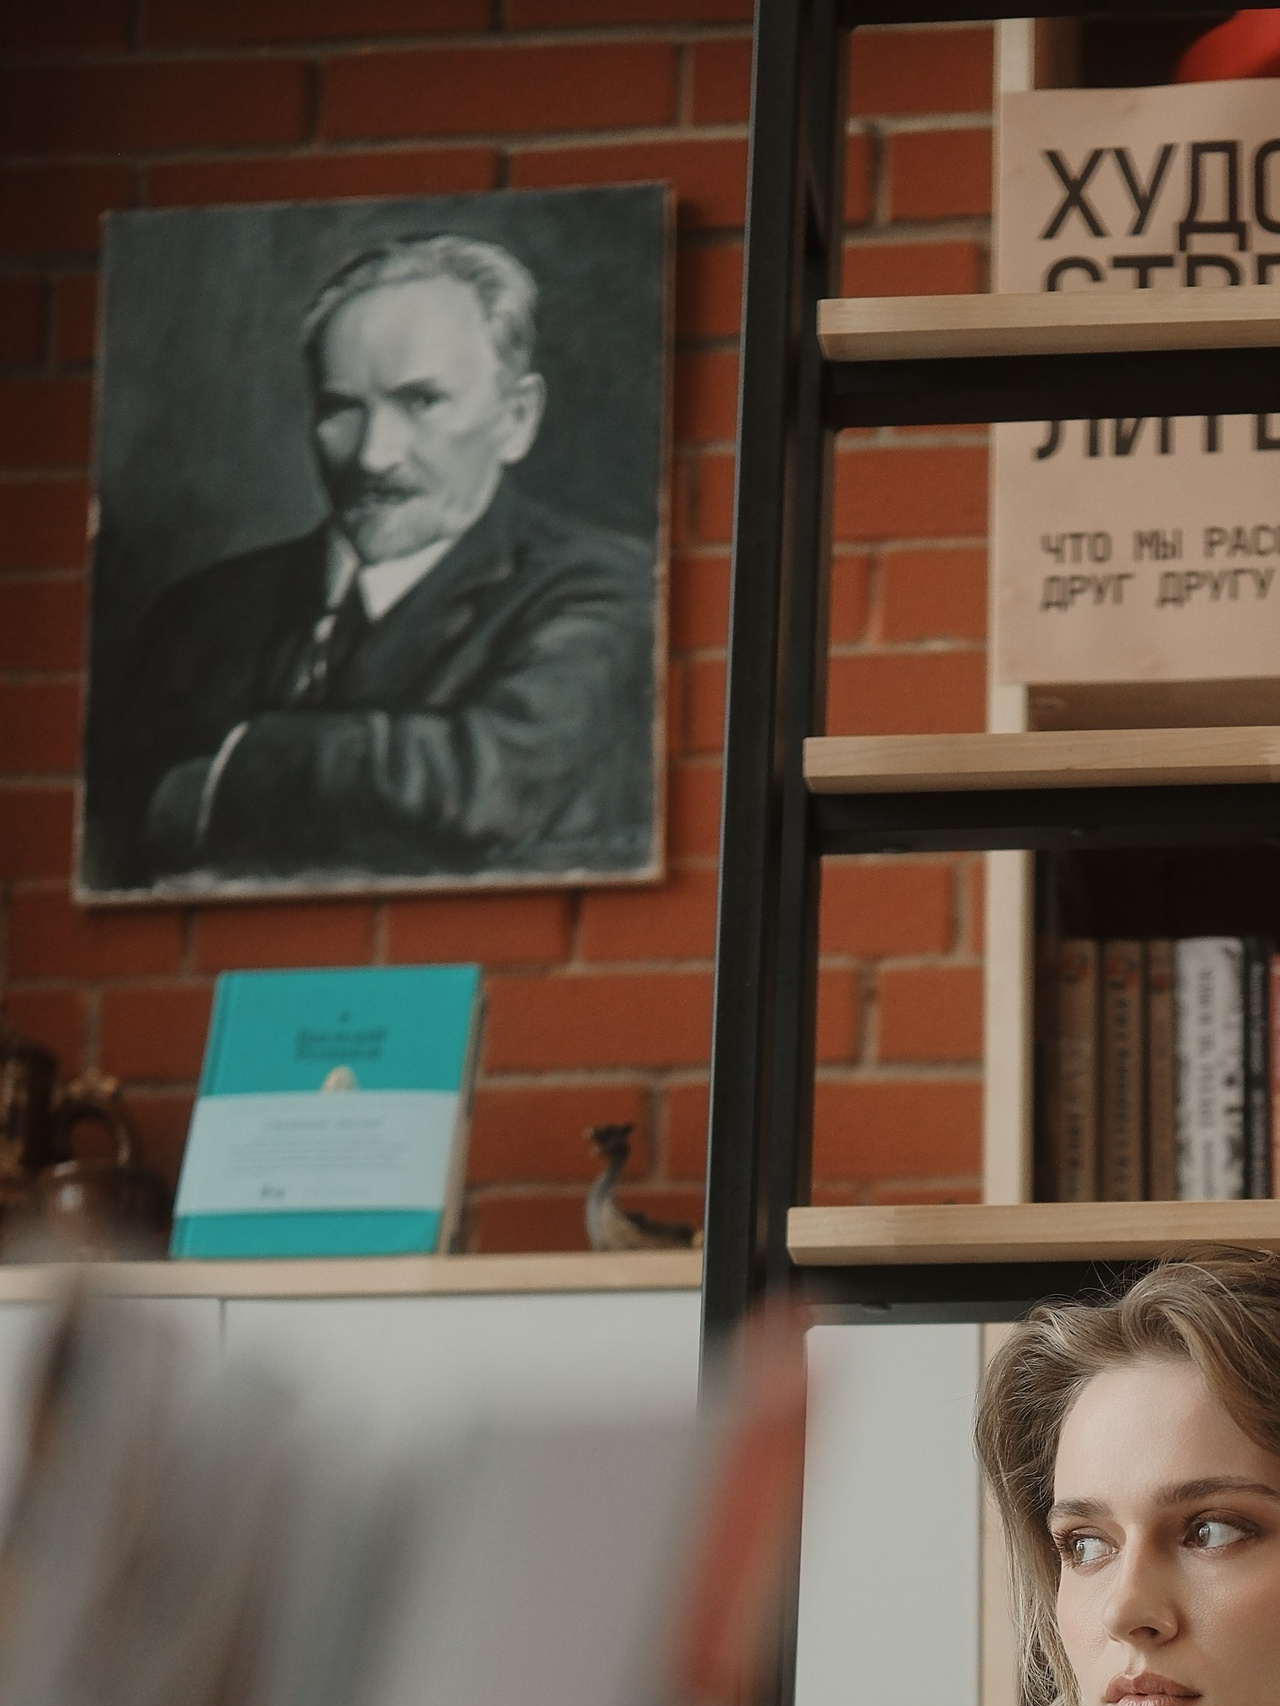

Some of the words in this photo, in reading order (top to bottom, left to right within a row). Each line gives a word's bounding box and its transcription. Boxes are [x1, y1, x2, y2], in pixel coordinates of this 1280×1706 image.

[1040, 531, 1113, 564] ЧТО
[1133, 529, 1183, 562] МЫ
[1039, 572, 1134, 612] ДРУГ
[1155, 567, 1276, 609] ДРУГУ
